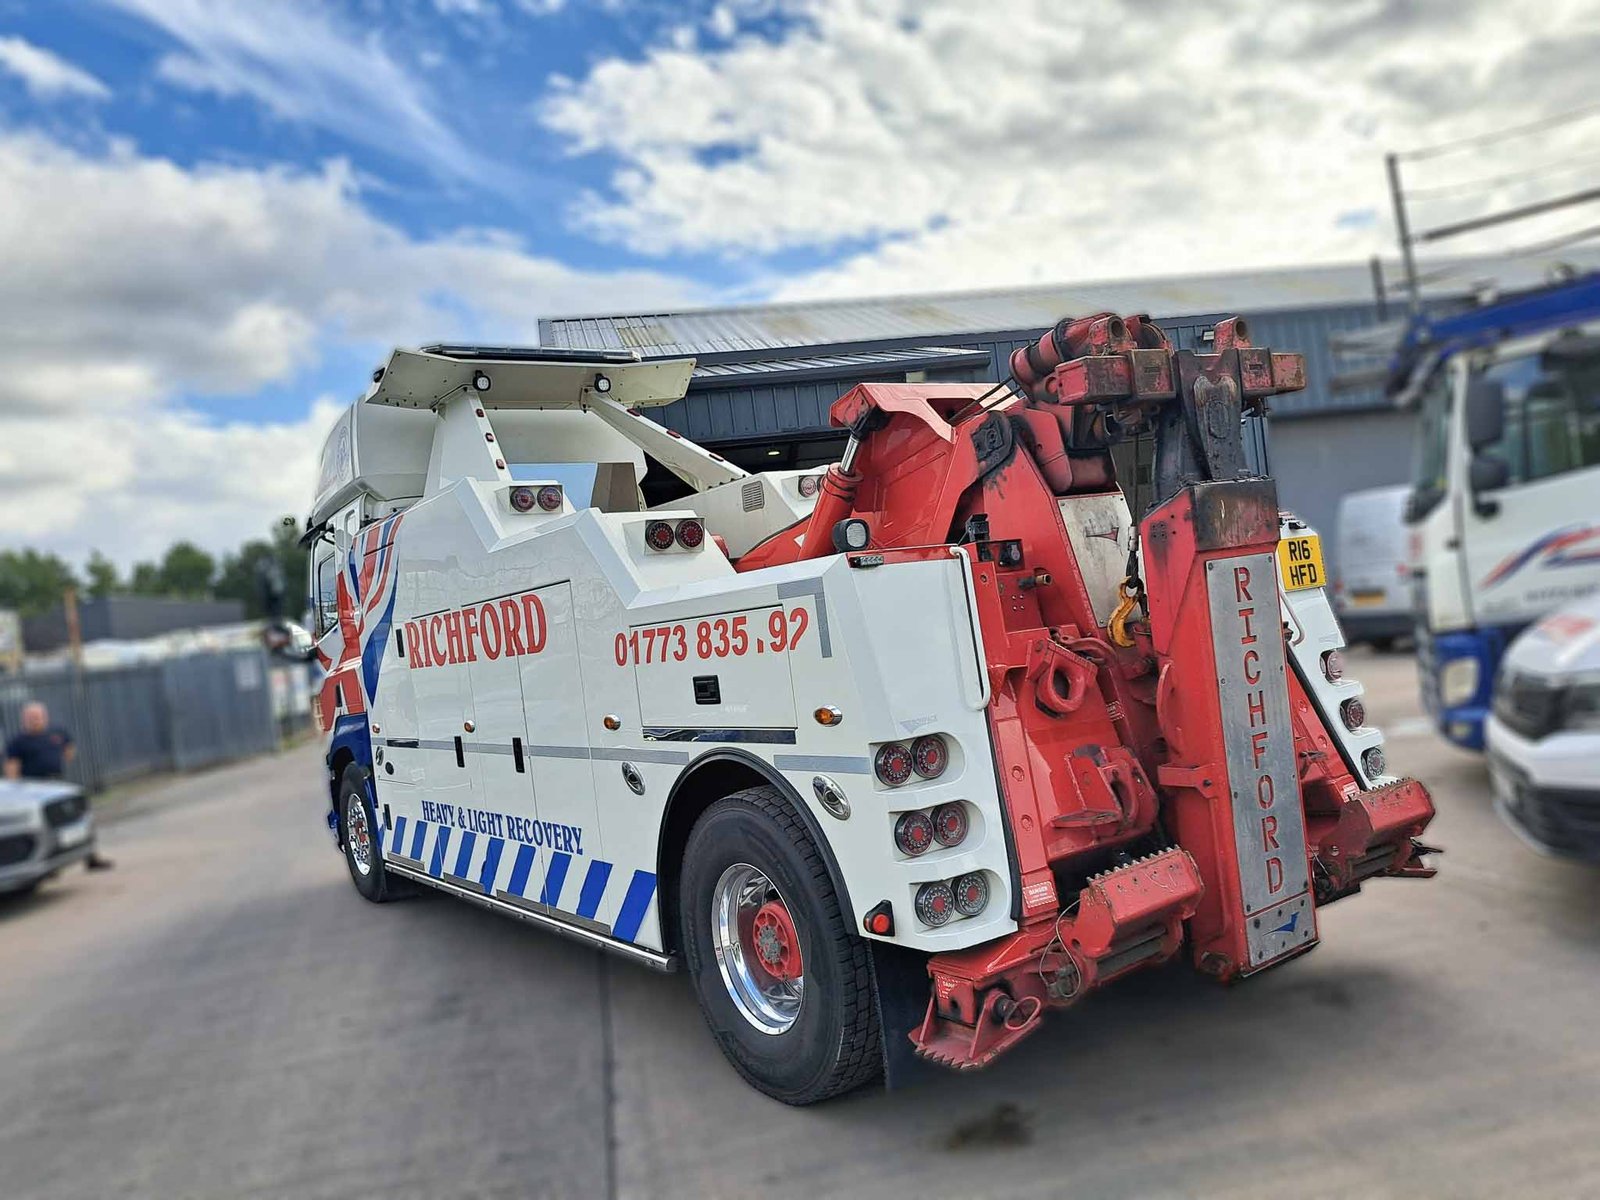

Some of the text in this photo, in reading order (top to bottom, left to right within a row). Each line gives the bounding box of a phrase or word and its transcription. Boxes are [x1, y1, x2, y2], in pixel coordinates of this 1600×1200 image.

[1288, 540, 1311, 562] R16
[1289, 563, 1318, 586] HFD
[404, 593, 547, 669] RICHFORD
[614, 624, 688, 667] 01773
[1233, 566, 1284, 895] RICHFORD
[421, 800, 584, 855] HEAVY & LIGHT RECOVERY
